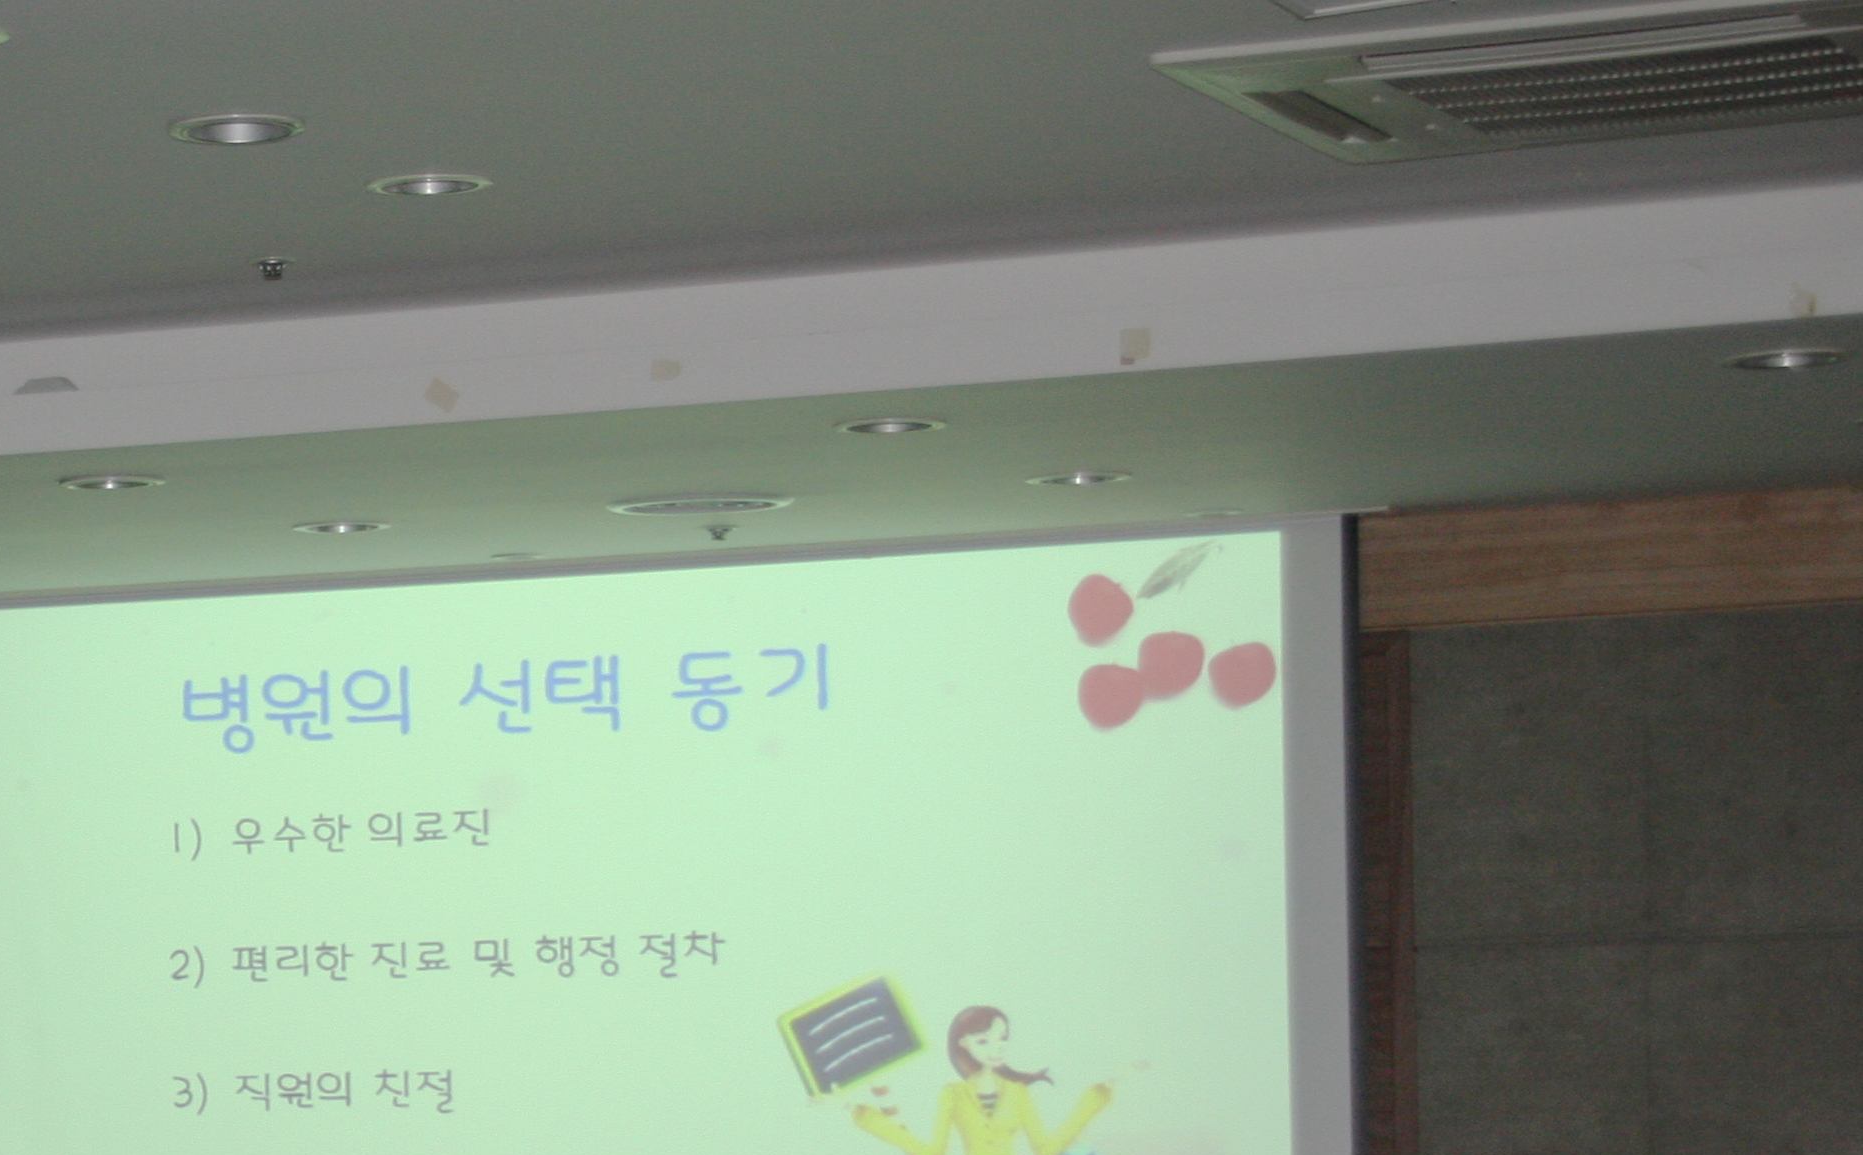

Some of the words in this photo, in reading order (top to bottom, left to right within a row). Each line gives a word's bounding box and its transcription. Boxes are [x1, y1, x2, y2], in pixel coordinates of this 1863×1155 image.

[182, 665, 411, 755] 병원의
[459, 654, 621, 734] 선택
[671, 642, 829, 732] 동기
[173, 818, 203, 862] 1)
[232, 813, 352, 855] 우수한
[367, 807, 490, 847] 의료진
[169, 946, 205, 989] 2)
[232, 942, 354, 983] 편리한
[371, 940, 450, 980] 진료
[473, 938, 515, 978] 및
[535, 934, 620, 979] 행정
[640, 930, 726, 980] 절차
[172, 1073, 209, 1116] 3)
[236, 1071, 352, 1111] 직원의
[375, 1069, 454, 1115] 친절
